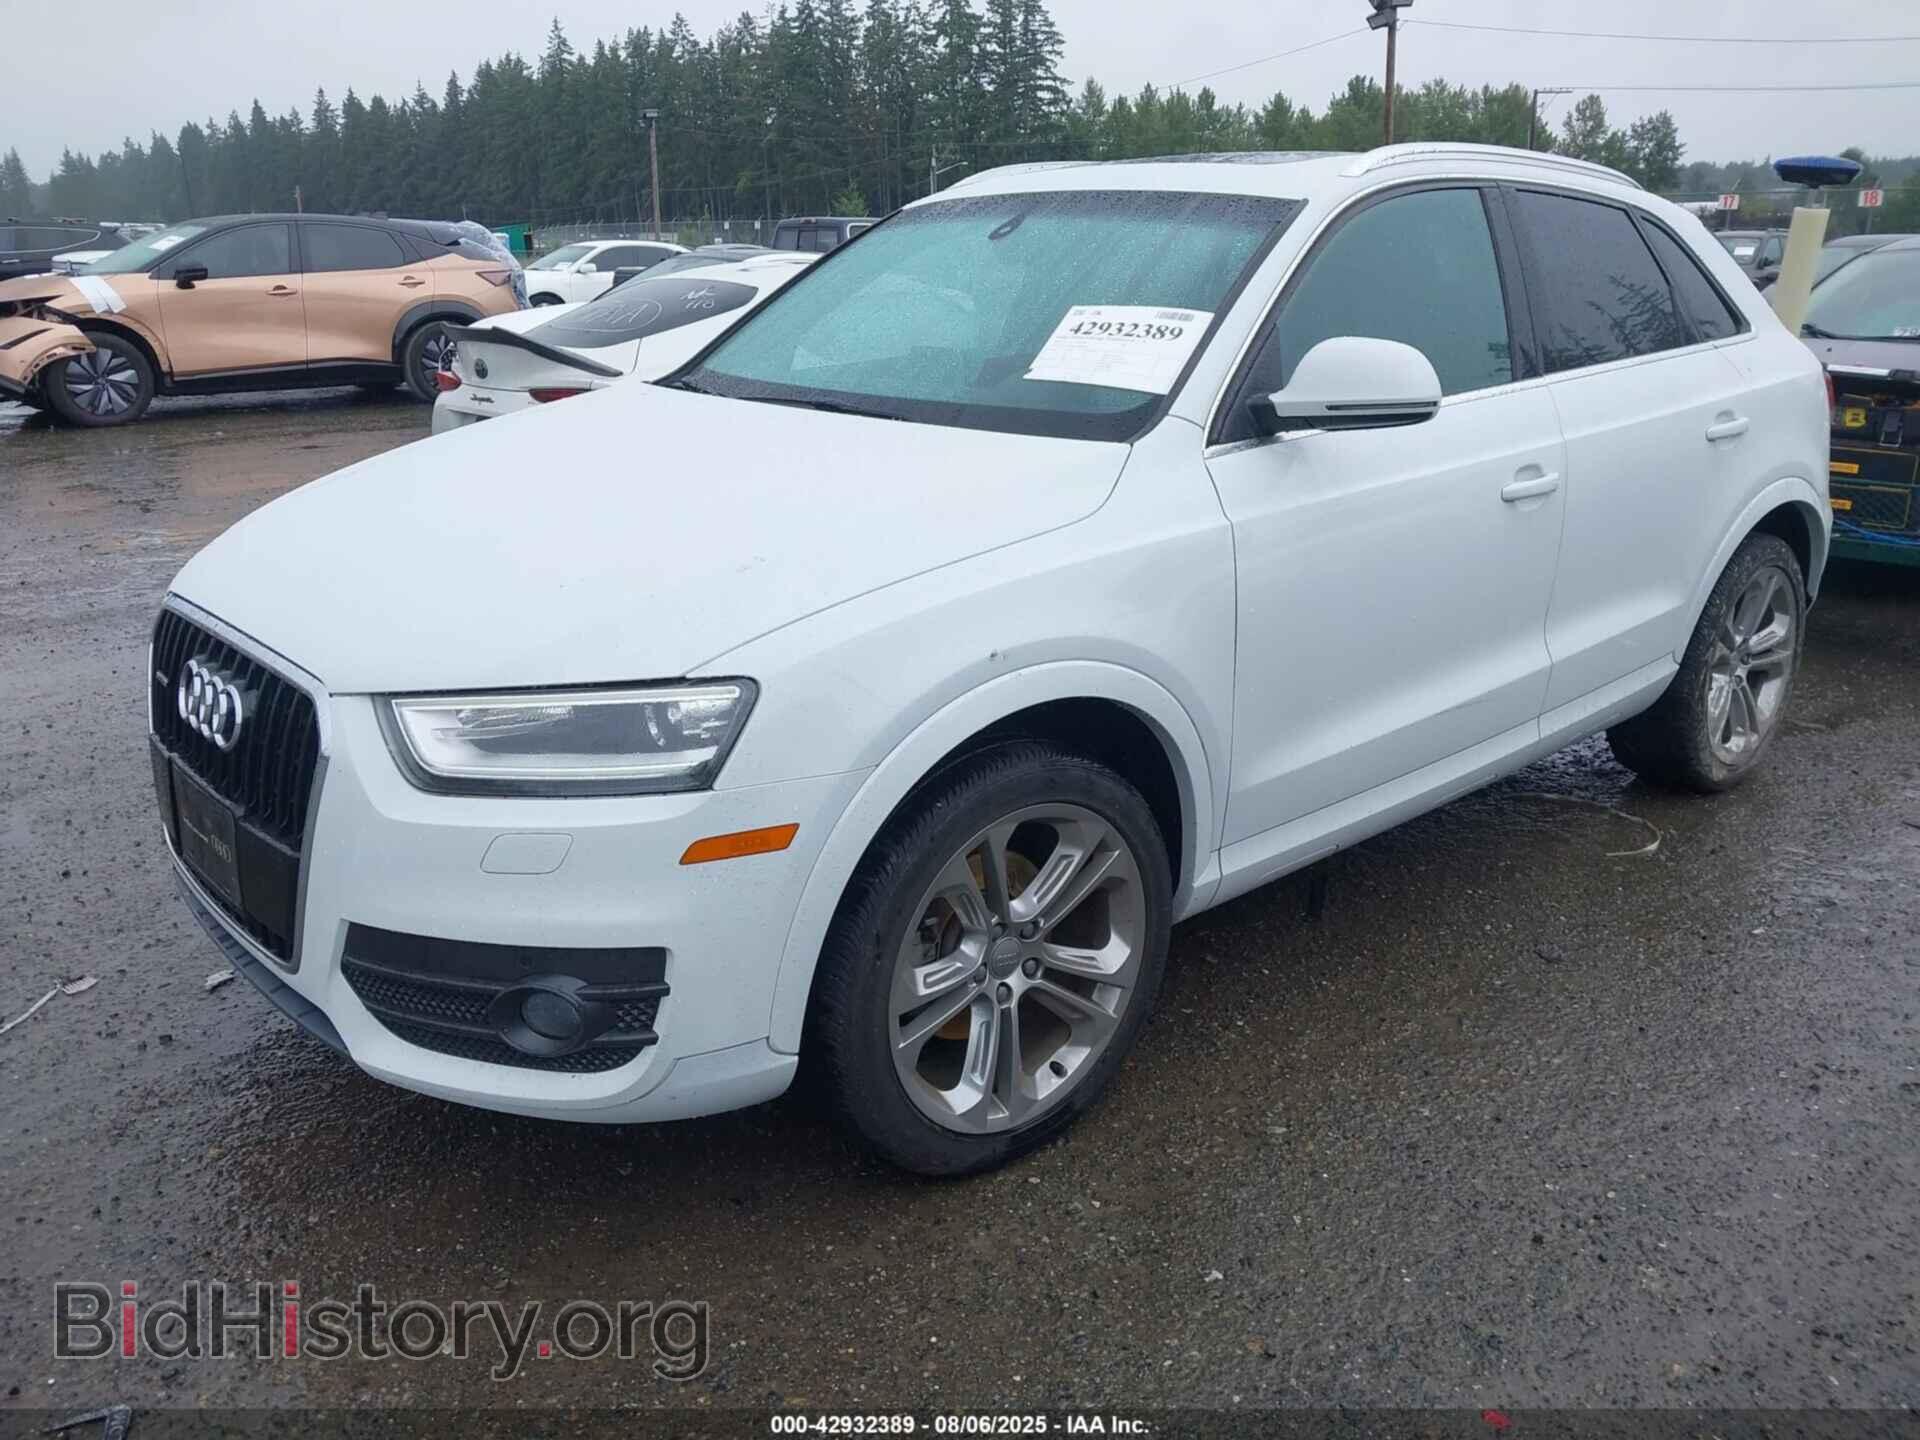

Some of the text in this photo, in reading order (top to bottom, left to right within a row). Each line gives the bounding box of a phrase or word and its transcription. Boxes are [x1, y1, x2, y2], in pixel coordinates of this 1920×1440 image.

[1722, 195, 1736, 209] 17
[1862, 191, 1879, 206] 18
[1069, 320, 1184, 341] 42932389
